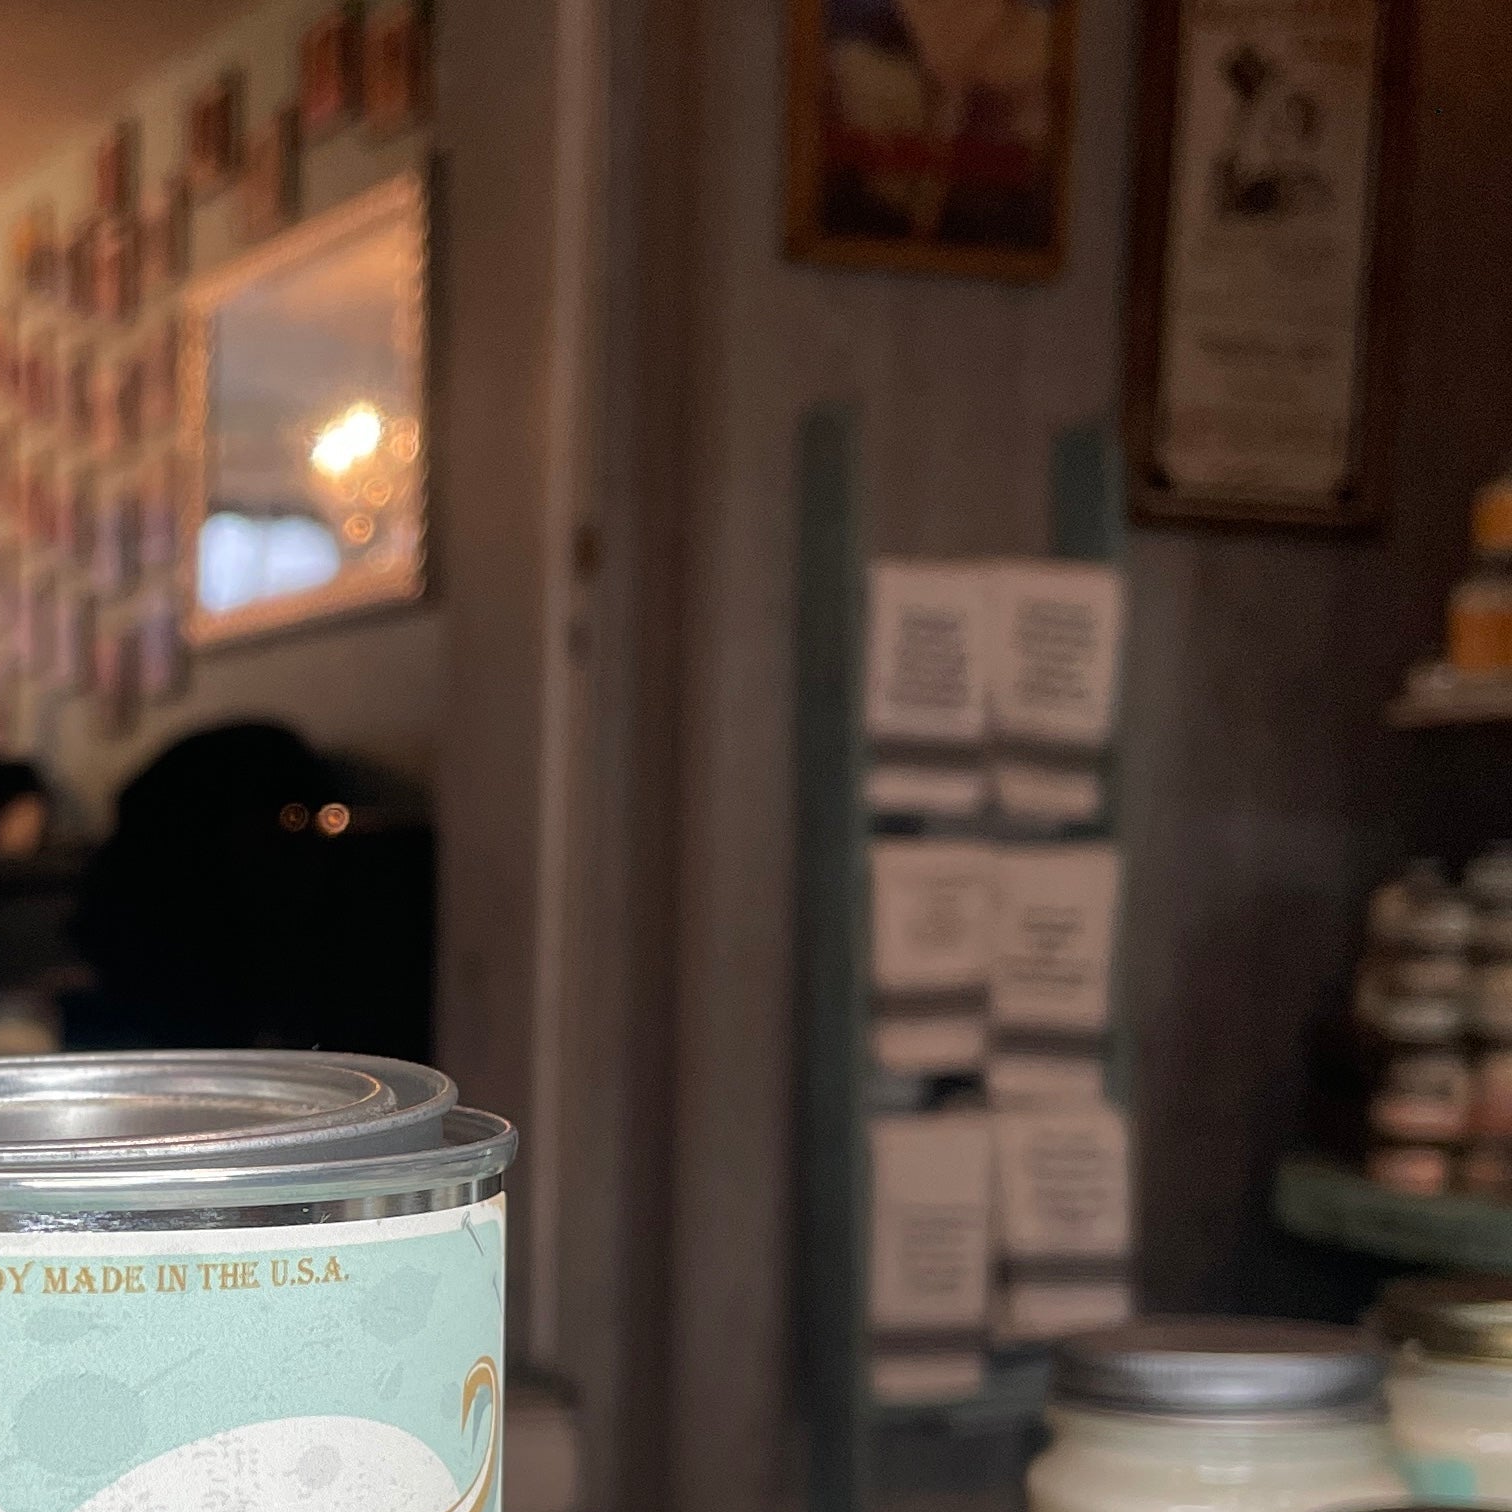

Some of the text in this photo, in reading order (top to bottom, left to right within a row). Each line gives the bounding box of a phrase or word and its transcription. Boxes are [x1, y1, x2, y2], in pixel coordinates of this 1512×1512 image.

[41, 1264, 147, 1295] MADE
[155, 1263, 188, 1293] IN
[196, 1260, 261, 1292] THE
[270, 1255, 351, 1287] U.S.A.
